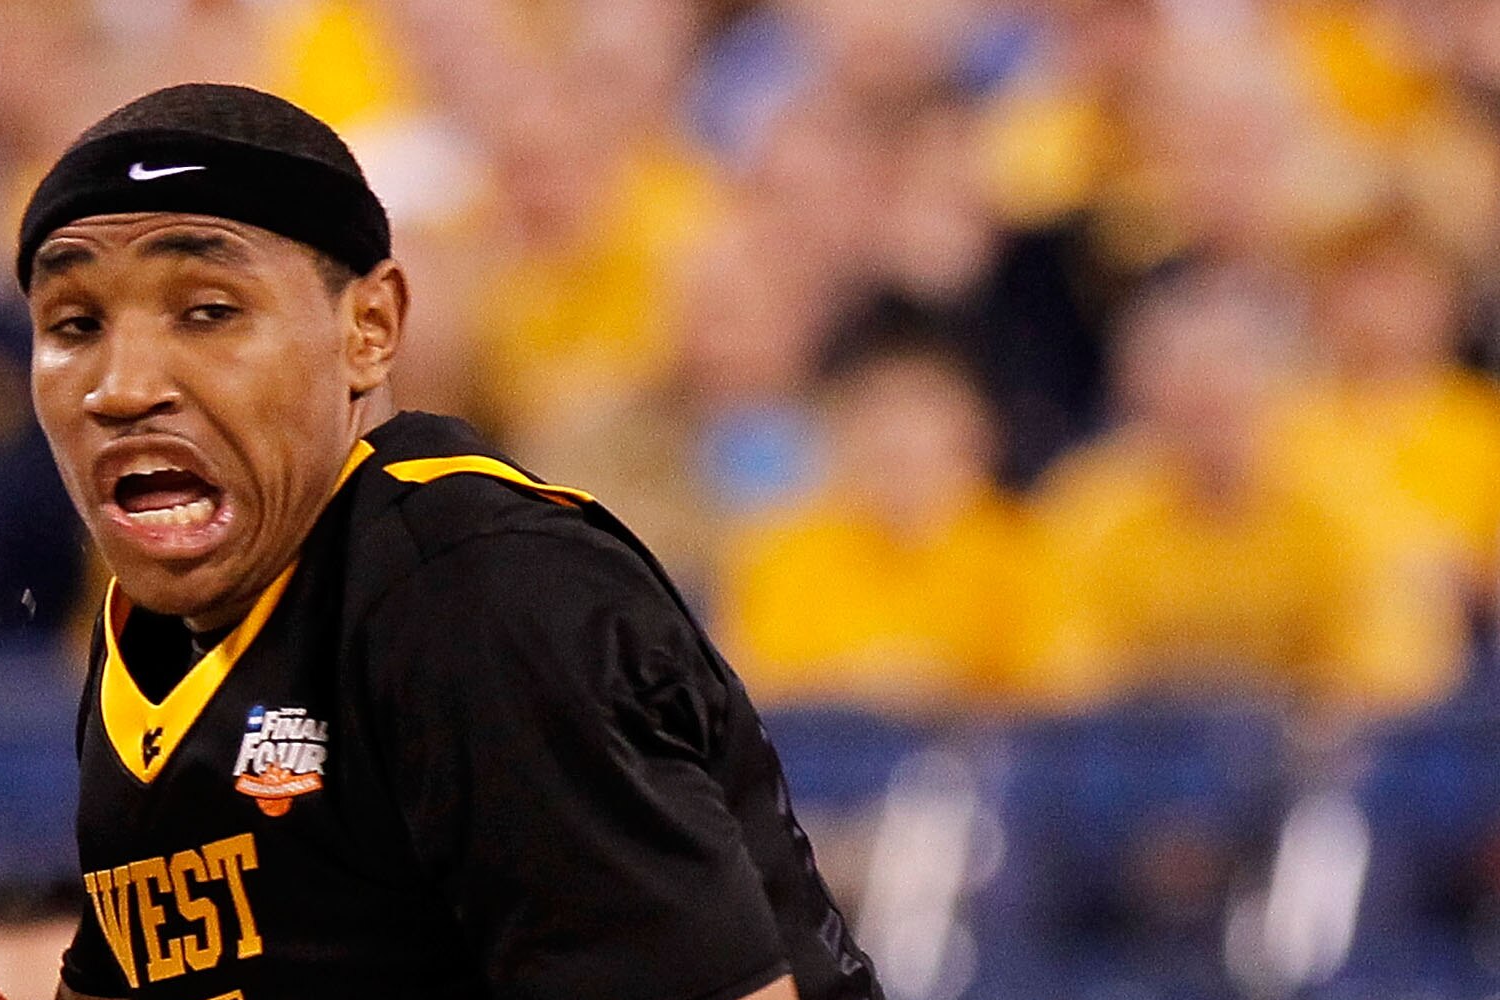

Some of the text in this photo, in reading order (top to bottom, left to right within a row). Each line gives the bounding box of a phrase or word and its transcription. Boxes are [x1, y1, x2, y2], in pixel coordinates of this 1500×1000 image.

[259, 710, 329, 742] FINAL
[232, 732, 328, 776] FOUR
[84, 832, 263, 988] WEST
